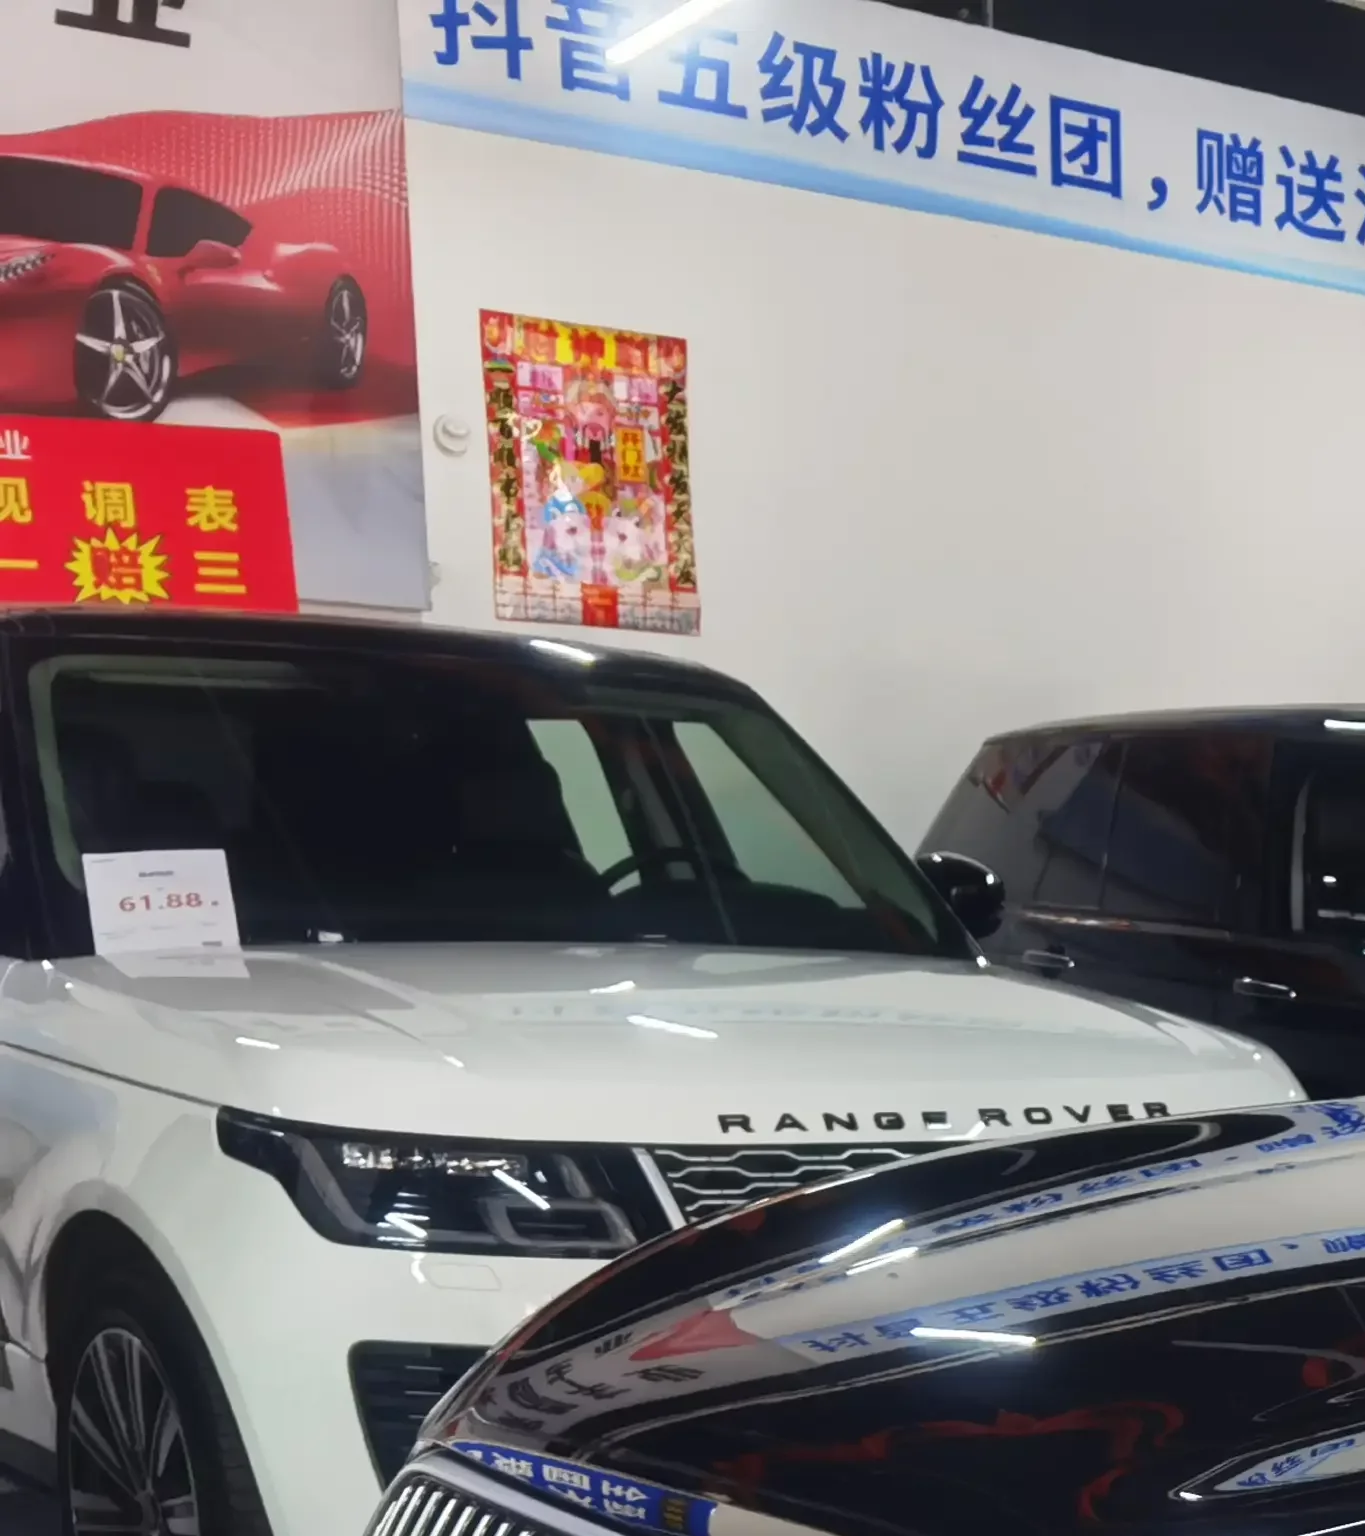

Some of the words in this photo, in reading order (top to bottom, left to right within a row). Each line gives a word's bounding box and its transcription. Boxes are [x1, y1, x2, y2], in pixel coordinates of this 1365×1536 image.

[119, 892, 204, 912] 61.88
[717, 1111, 948, 1134] RANGE
[977, 1101, 1172, 1127] ROVER
